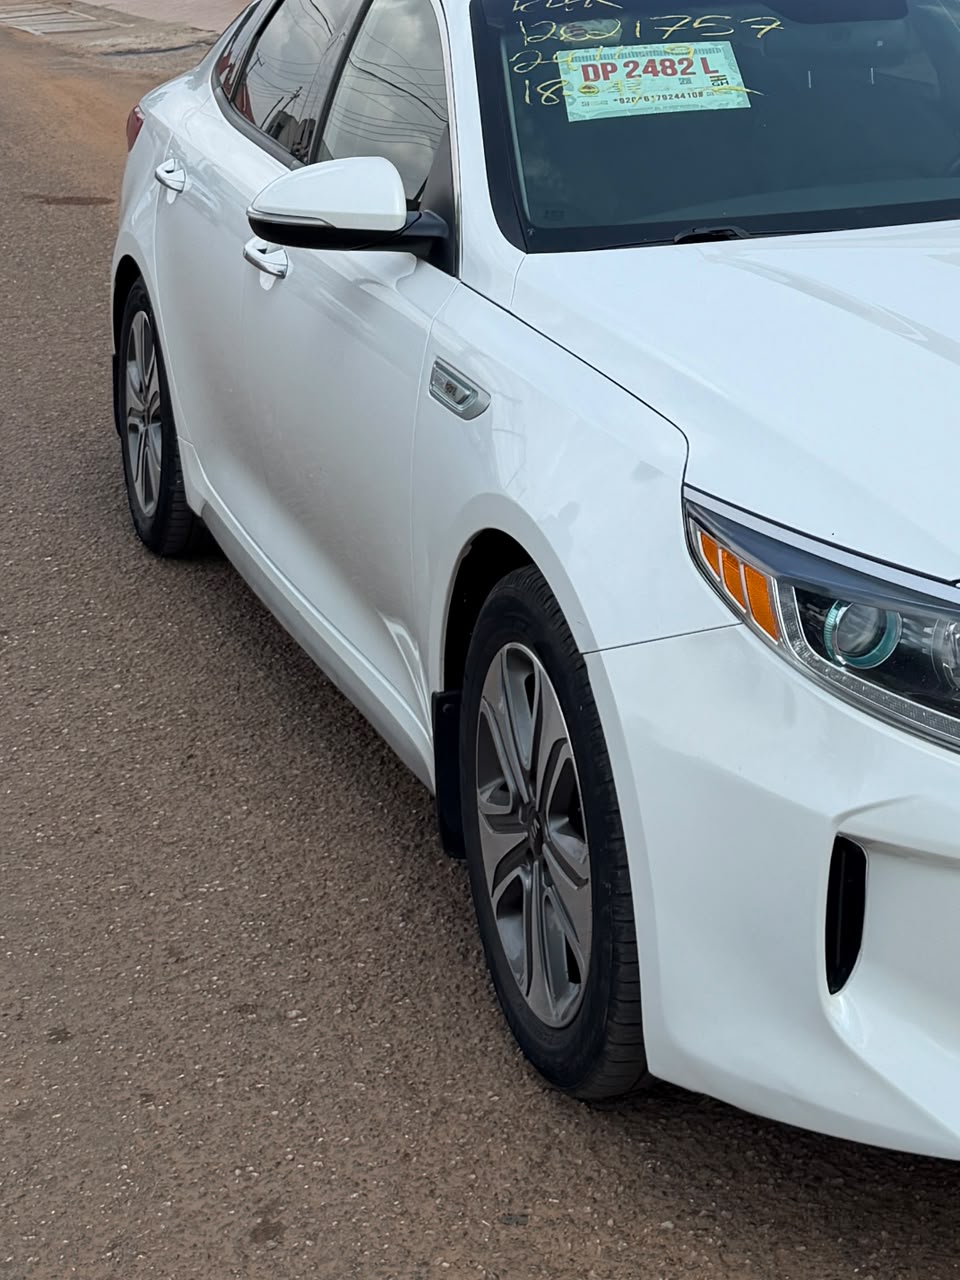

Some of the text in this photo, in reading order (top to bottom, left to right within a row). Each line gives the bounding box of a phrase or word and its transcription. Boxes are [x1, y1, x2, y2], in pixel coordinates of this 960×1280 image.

[581, 57, 719, 82] DP 2482 L
